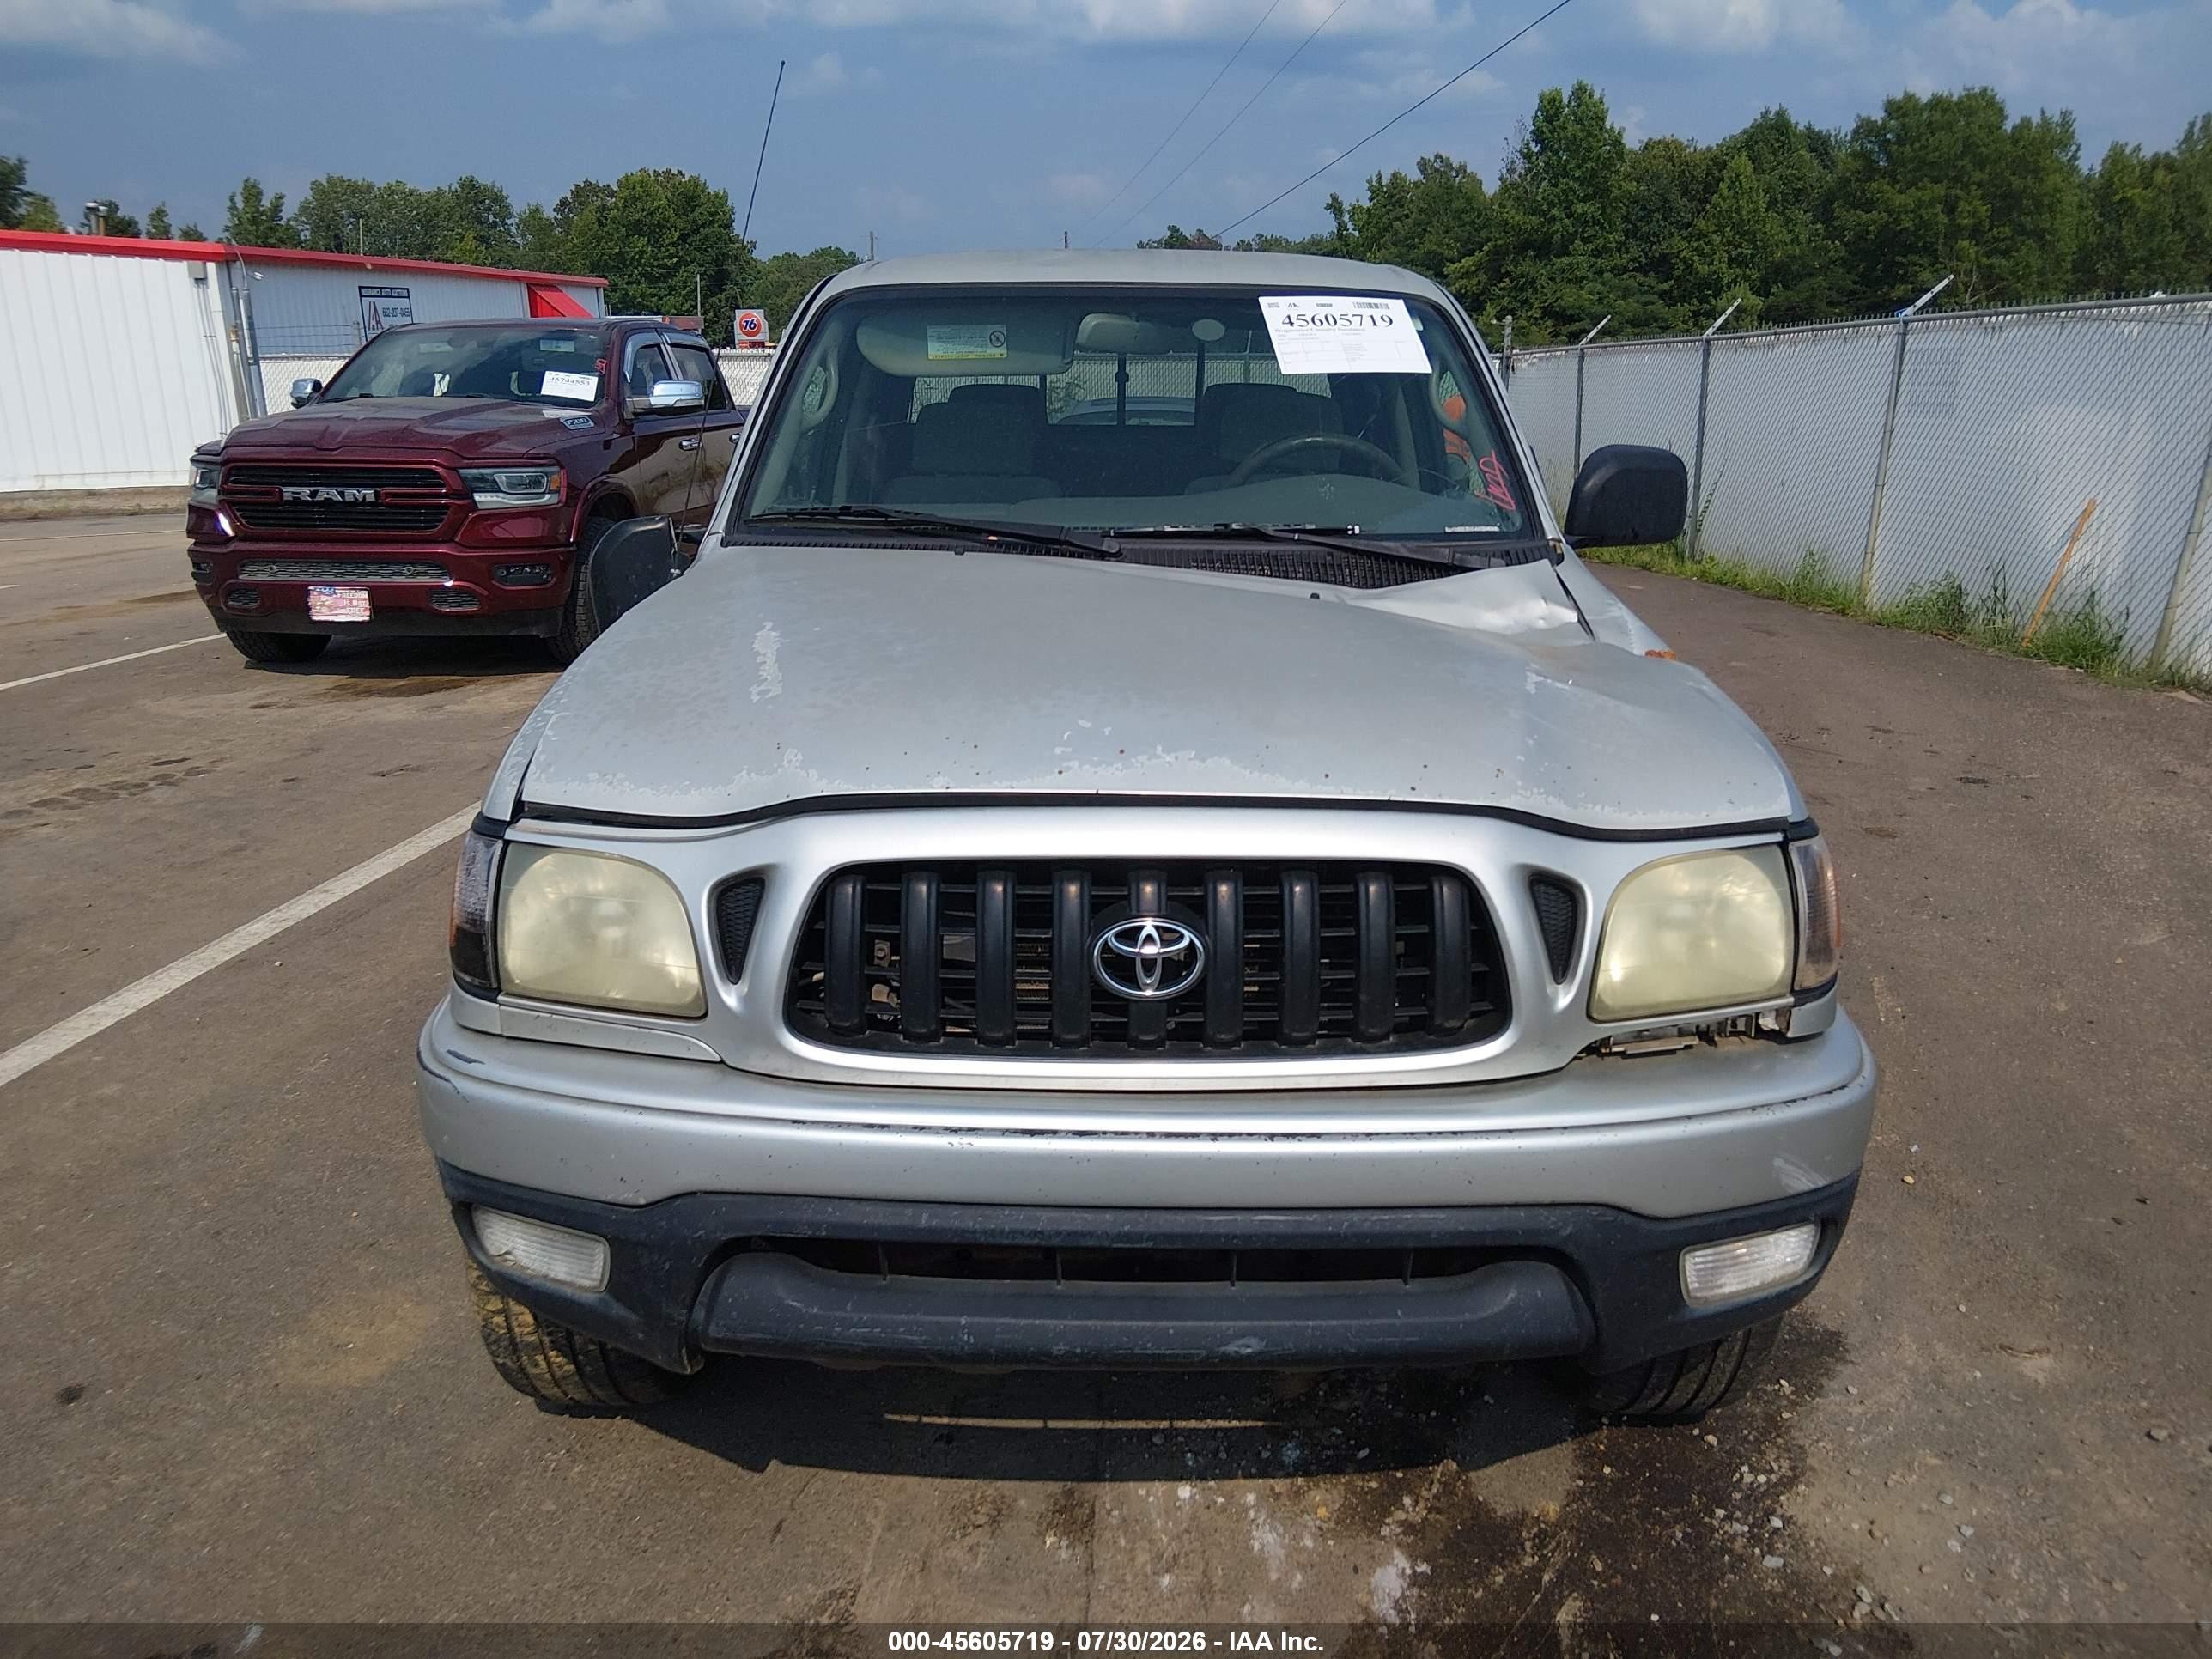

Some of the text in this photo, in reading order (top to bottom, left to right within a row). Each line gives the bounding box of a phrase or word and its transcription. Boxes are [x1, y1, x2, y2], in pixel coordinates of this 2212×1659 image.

[742, 318, 757, 331] 76
[1282, 313, 1394, 328] 45605719
[282, 488, 376, 501] RAM
